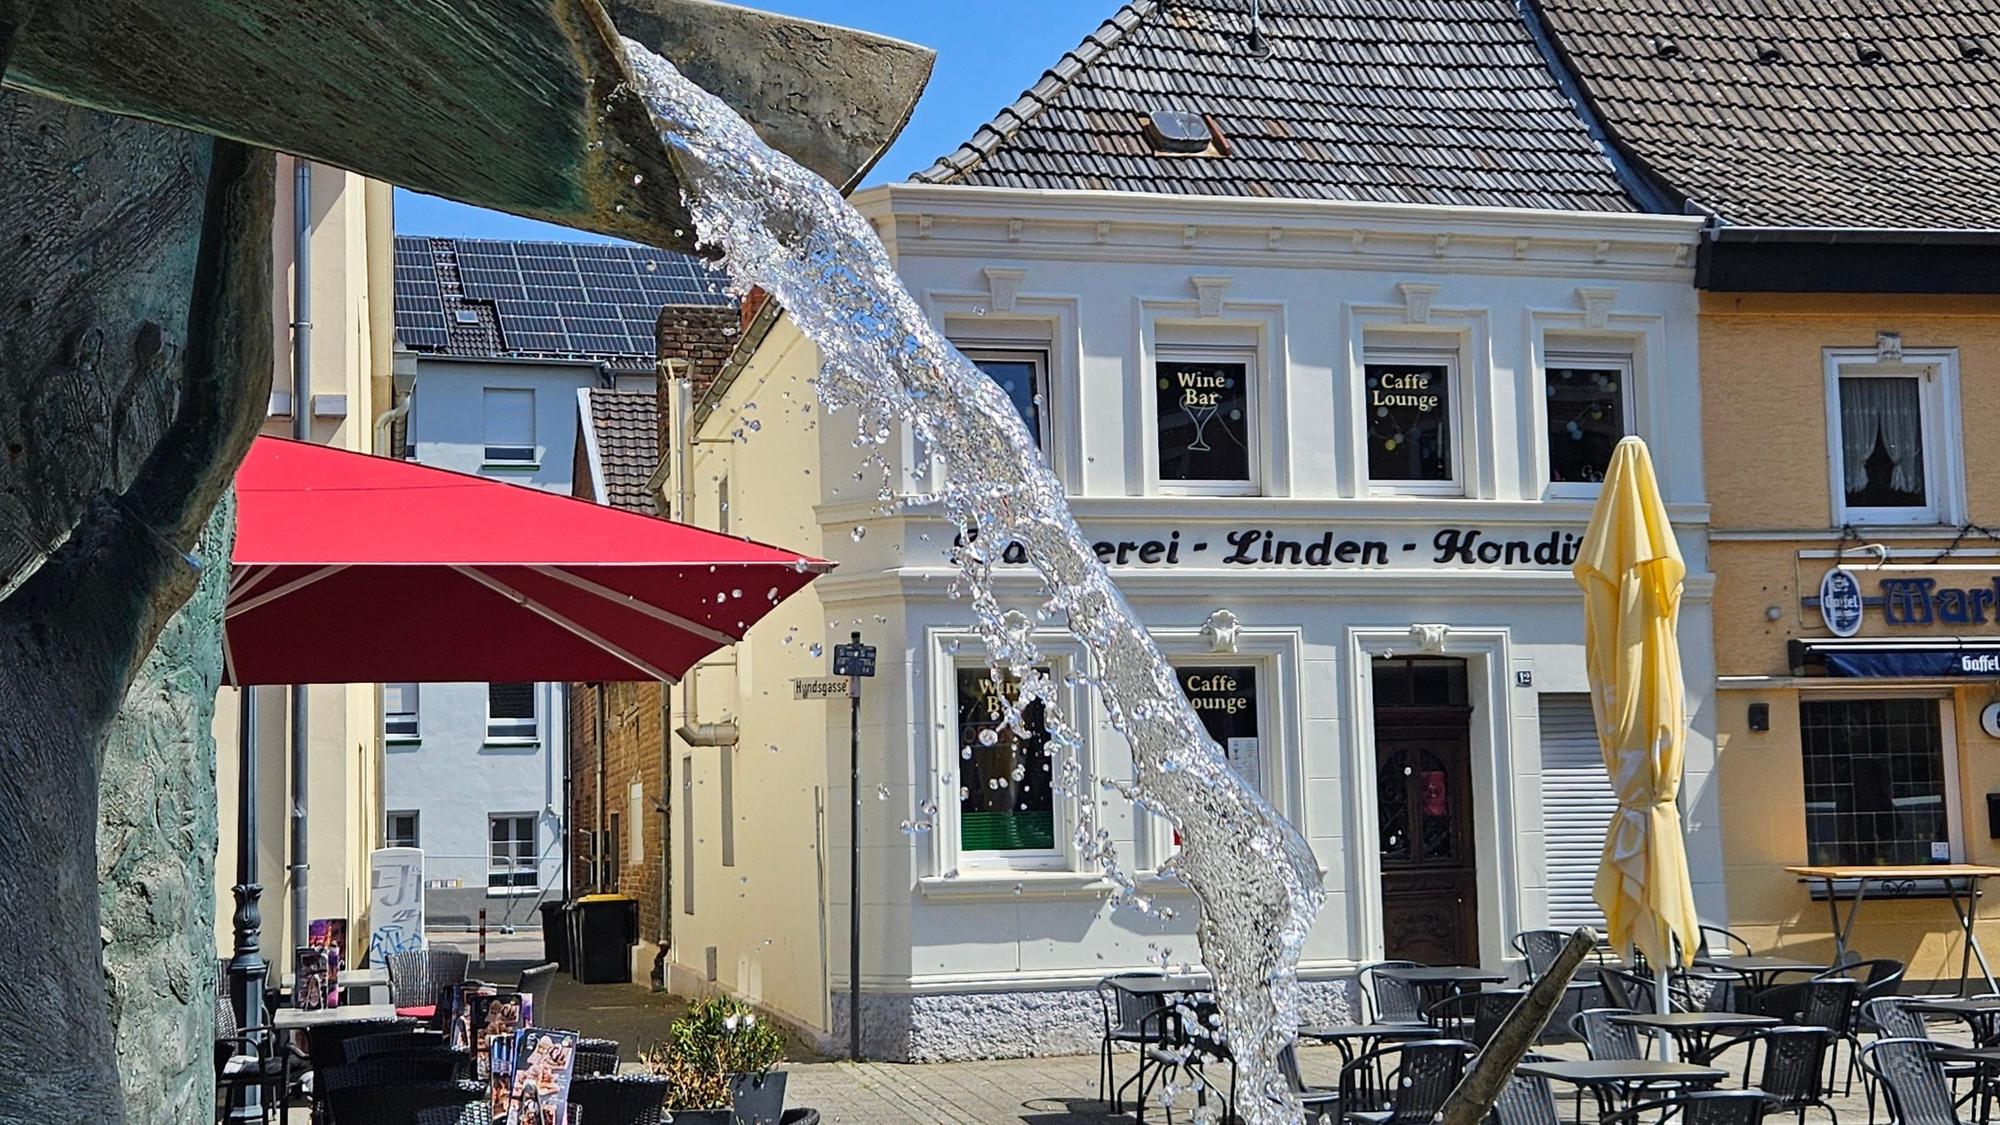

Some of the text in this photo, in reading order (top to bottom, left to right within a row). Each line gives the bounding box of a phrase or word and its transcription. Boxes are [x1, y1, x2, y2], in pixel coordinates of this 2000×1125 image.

[1177, 371, 1225, 388] Wine
[1185, 388, 1219, 405] Bar
[1372, 390, 1439, 412] Lounge
[1222, 529, 1389, 566] Linden
[1962, 655, 2000, 672] Gaffel
[1191, 696, 1248, 714] ounge
